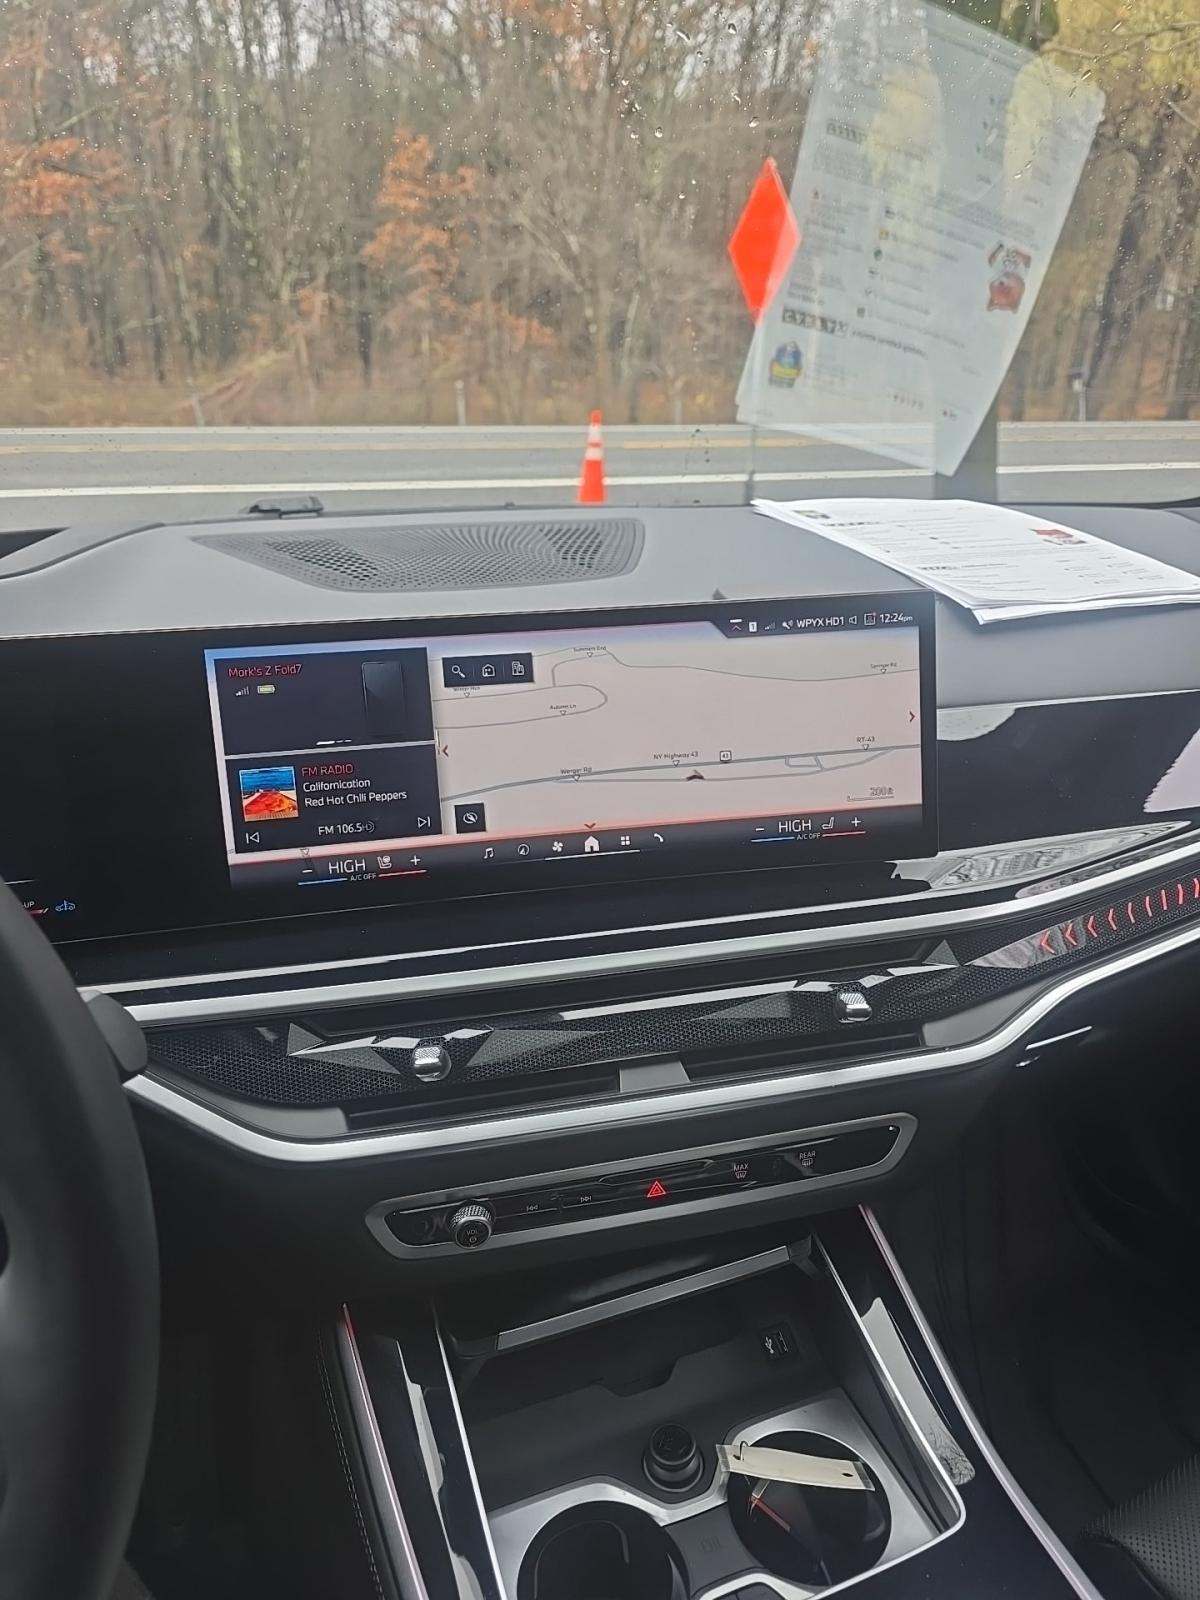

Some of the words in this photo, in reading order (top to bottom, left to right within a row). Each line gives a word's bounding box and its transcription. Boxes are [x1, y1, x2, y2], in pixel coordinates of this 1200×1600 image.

[796, 618, 825, 628] WPYX
[825, 616, 844, 627] HD1
[880, 613, 913, 623] 12:24pm
[228, 667, 262, 677] Mark's
[265, 665, 272, 676] Z
[274, 664, 302, 675] Fold7
[301, 767, 318, 776] FM
[320, 764, 354, 775] RADIO
[303, 779, 370, 792] Californication
[305, 796, 324, 807] Red
[326, 795, 345, 805] Hot
[368, 791, 407, 802] Peppers
[318, 825, 334, 836] FM
[335, 822, 362, 834] 106.5
[778, 819, 812, 832] HIGH
[796, 833, 808, 841] A/C
[808, 832, 821, 840] OFF
[328, 858, 366, 874] HIGH
[363, 872, 377, 880] OFF
[800, 1150, 816, 1160] REAR
[733, 1162, 749, 1172] MAX
